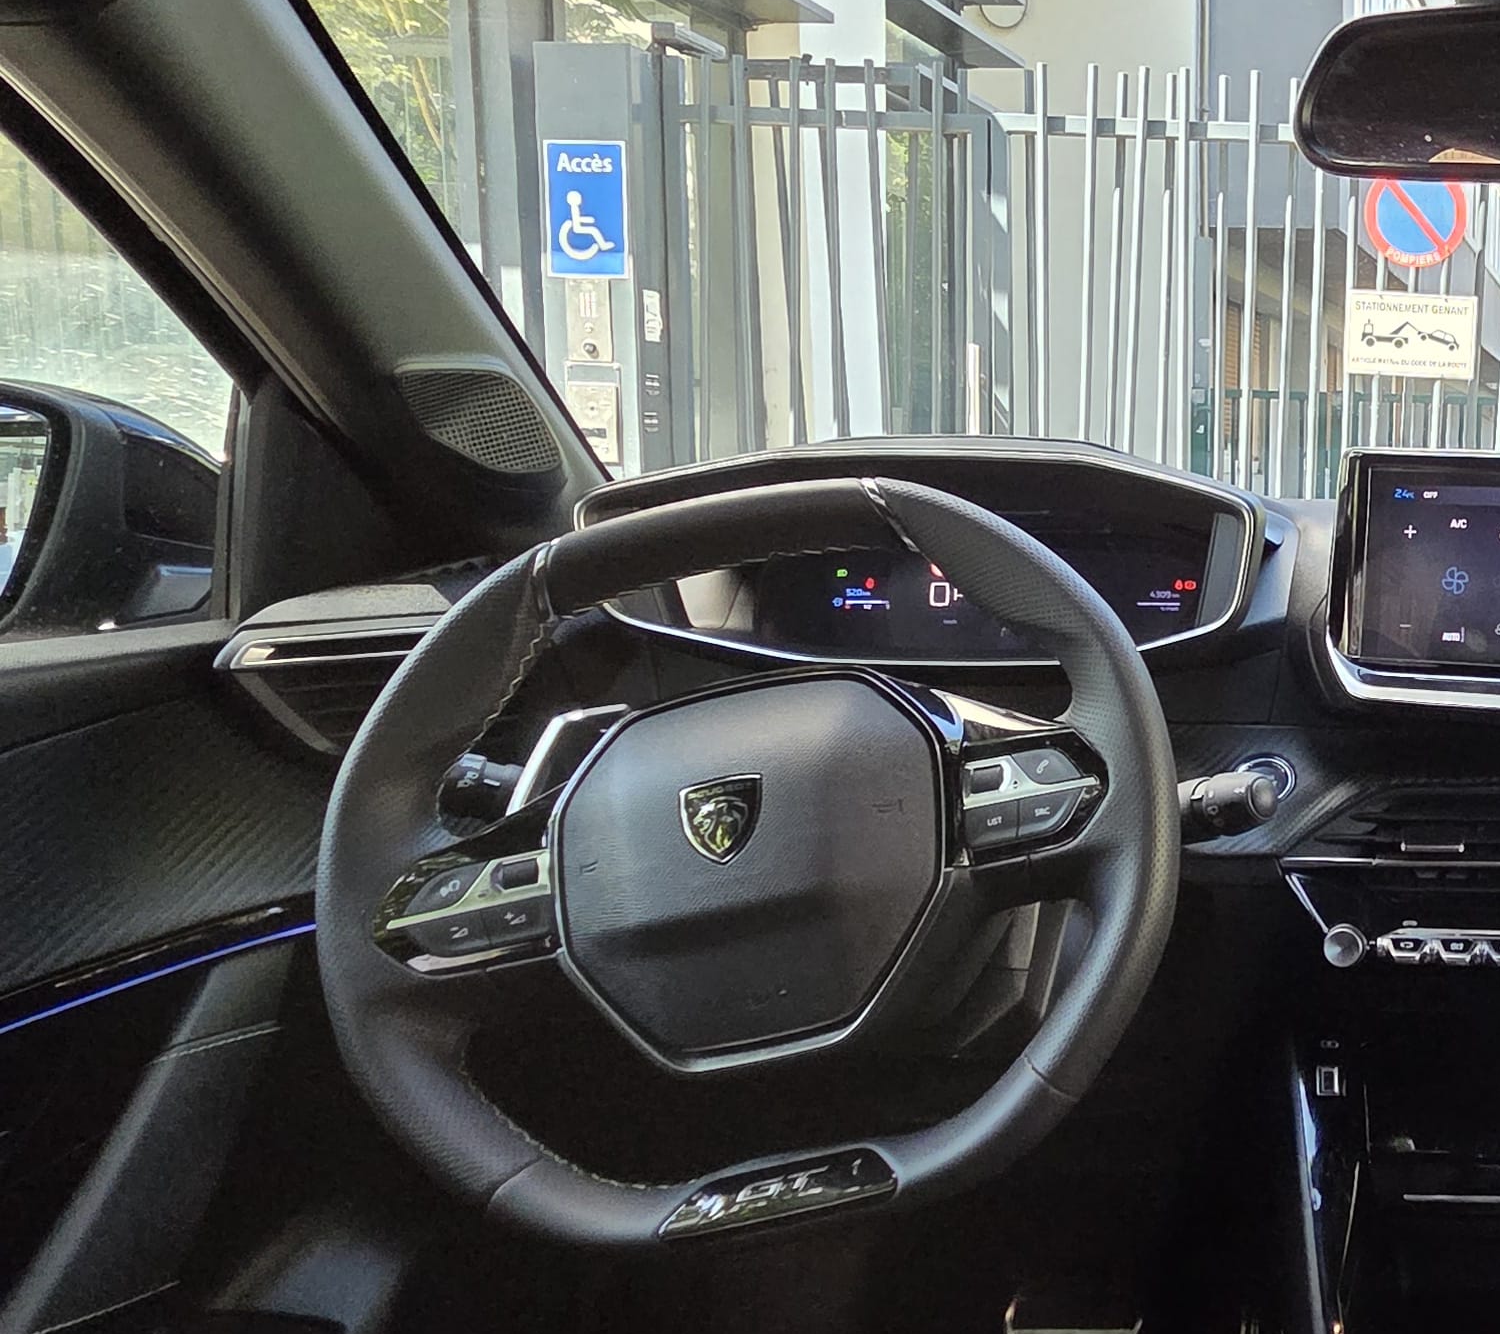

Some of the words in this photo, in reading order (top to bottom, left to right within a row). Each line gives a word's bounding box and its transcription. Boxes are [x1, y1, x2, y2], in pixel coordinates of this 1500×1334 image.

[556, 151, 613, 174] Accès
[1384, 246, 1441, 264] POMPIERS
[1355, 300, 1428, 314] STATIONNEMENT
[1450, 519, 1467, 529] A/C
